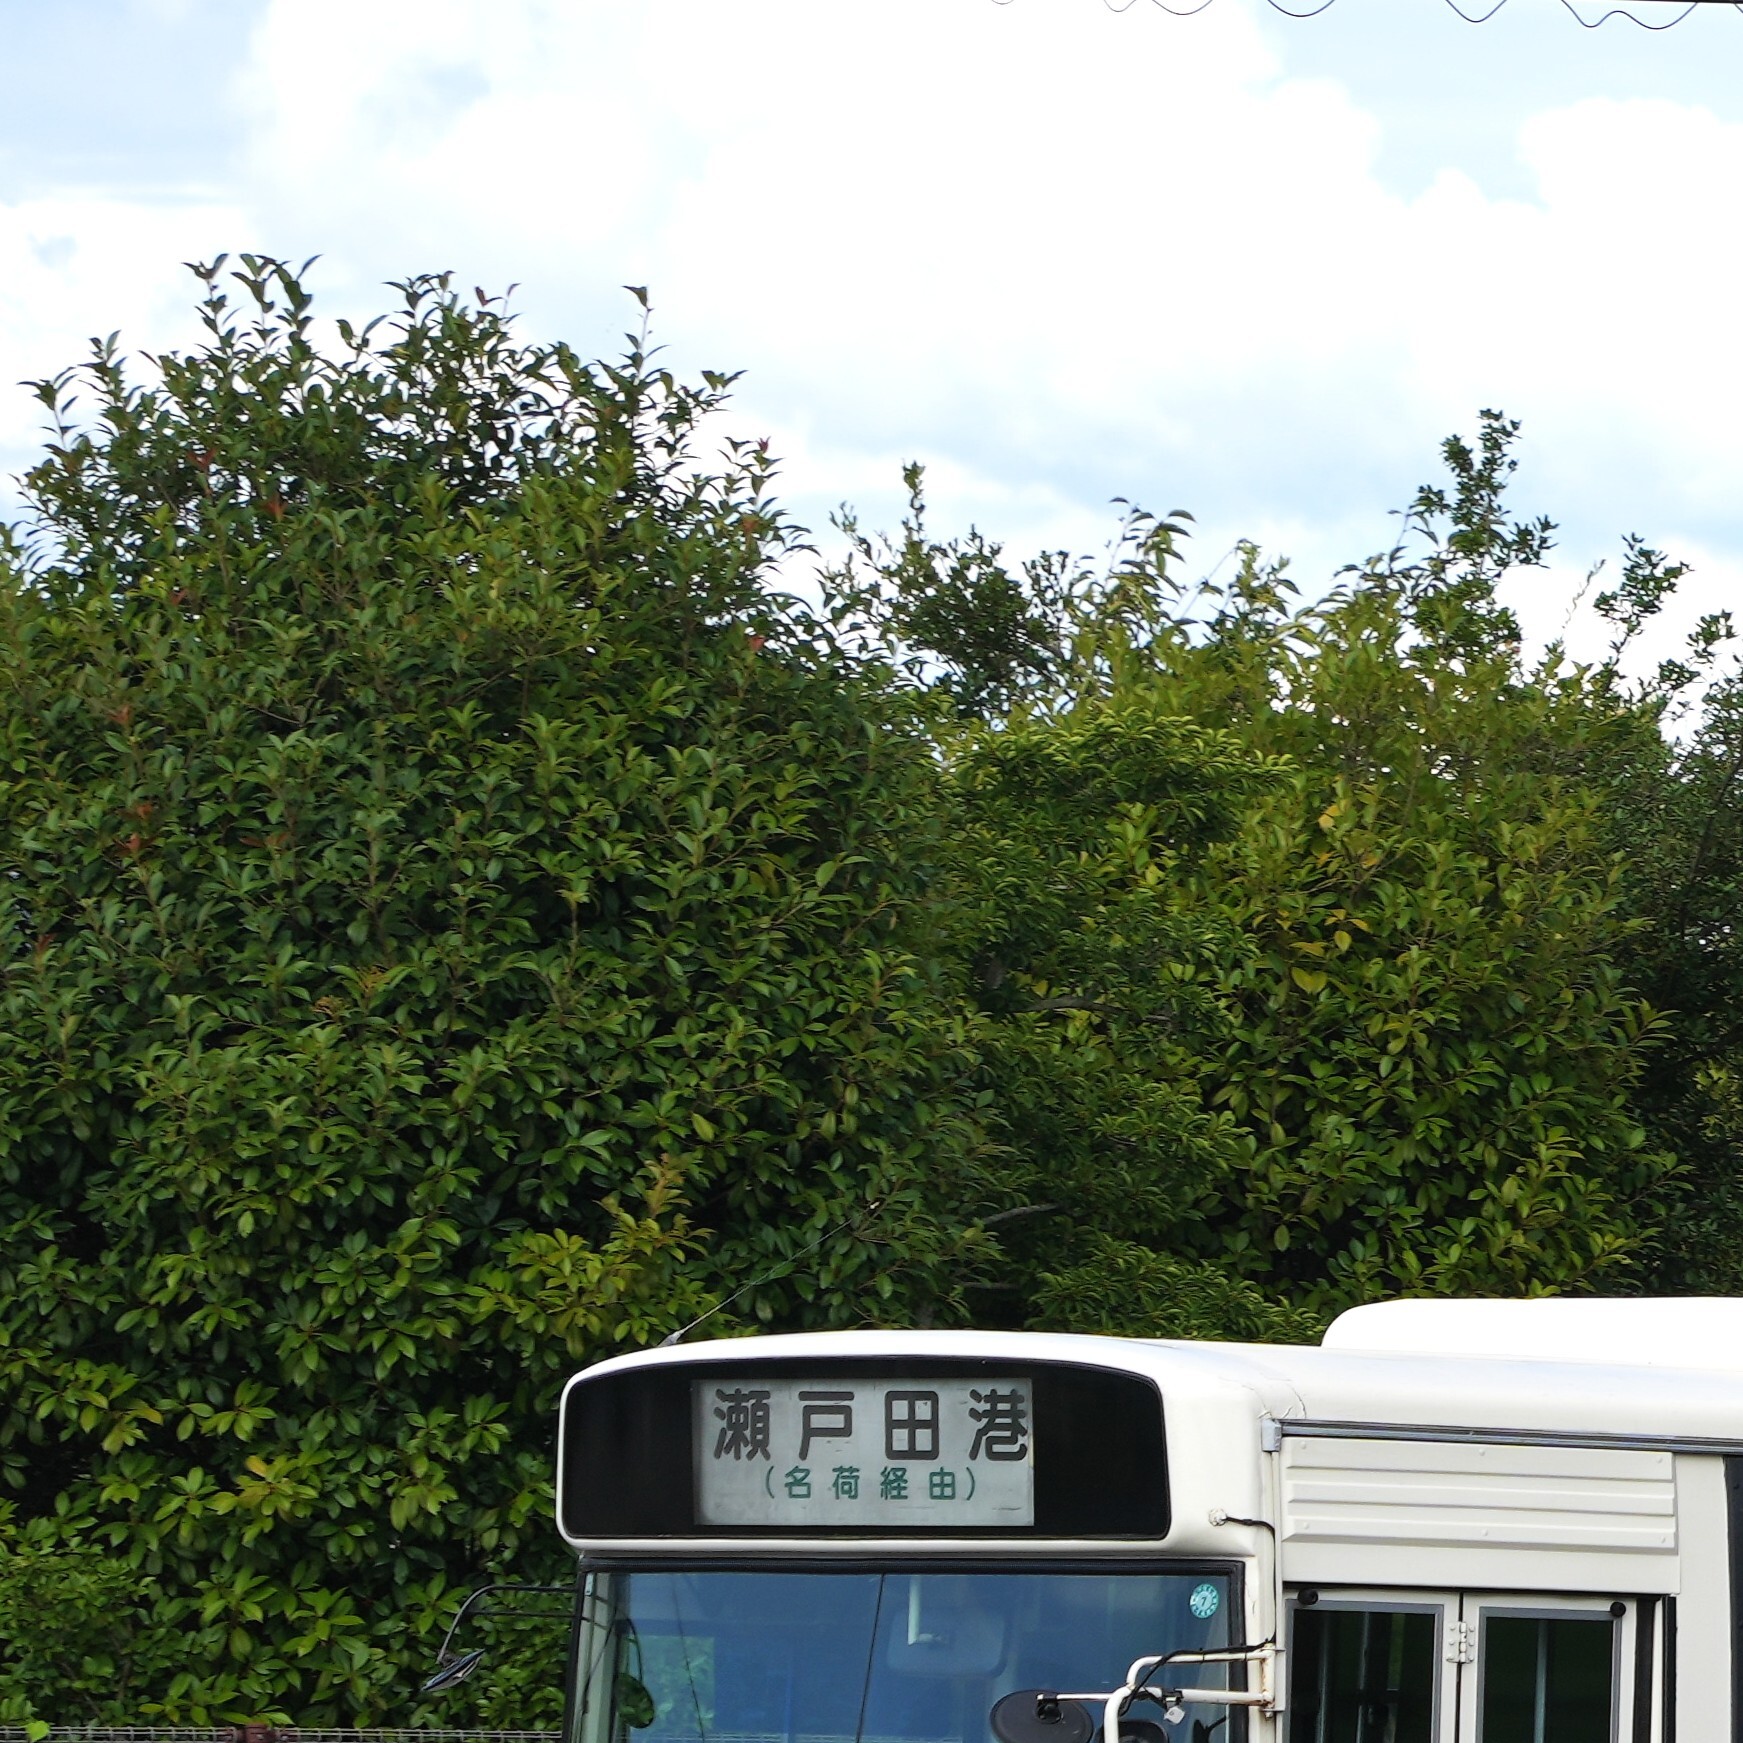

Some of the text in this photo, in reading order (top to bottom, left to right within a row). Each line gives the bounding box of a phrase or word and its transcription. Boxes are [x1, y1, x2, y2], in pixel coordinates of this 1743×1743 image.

[712, 1389, 1029, 1461] 瀬戸田港
[766, 1466, 976, 1500] (名荷経由)
